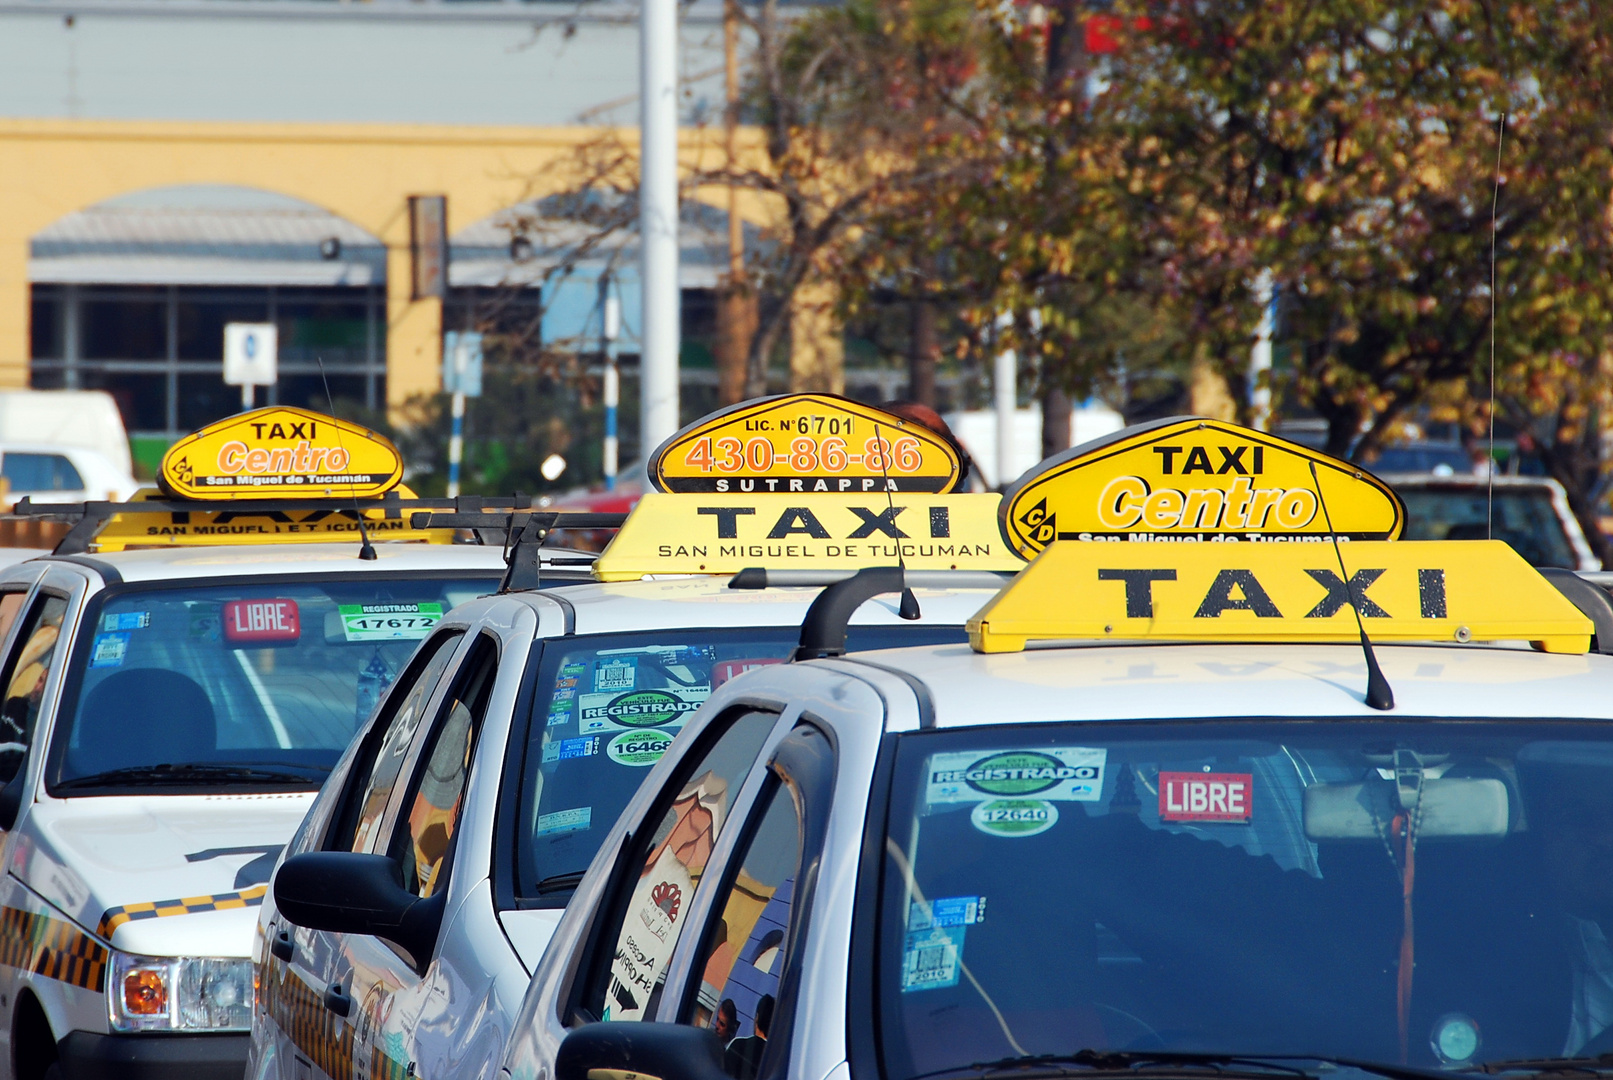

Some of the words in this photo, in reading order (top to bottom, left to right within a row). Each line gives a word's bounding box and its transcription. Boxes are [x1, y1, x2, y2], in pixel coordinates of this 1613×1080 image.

[250, 422, 317, 440] TAXI
[745, 420, 775, 431] LIC.
[797, 416, 851, 435] 6701
[217, 440, 350, 474] Centro
[684, 436, 923, 473] 430-86-86
[1153, 446, 1264, 475] TAXI
[206, 475, 233, 485] San
[236, 475, 283, 486] Miguel
[285, 475, 304, 484] de
[716, 478, 899, 493] SUTRAPPA
[1098, 475, 1319, 529] Centro
[147, 526, 186, 535] SAN
[697, 506, 951, 539] TAXI
[658, 545, 707, 557] SAN
[720, 545, 815, 557] MIGUEL
[826, 545, 858, 557] DE
[867, 544, 990, 557] TUCUMAN
[1098, 568, 1447, 619] TAXI
[234, 603, 290, 632] LIBRE
[362, 604, 419, 613] REGISTRADO
[356, 617, 435, 629] 17672
[614, 740, 673, 754] 16468
[936, 767, 1095, 783] REGISTRADO
[1167, 782, 1245, 813] LIBRE
[983, 809, 1049, 821] 12640
